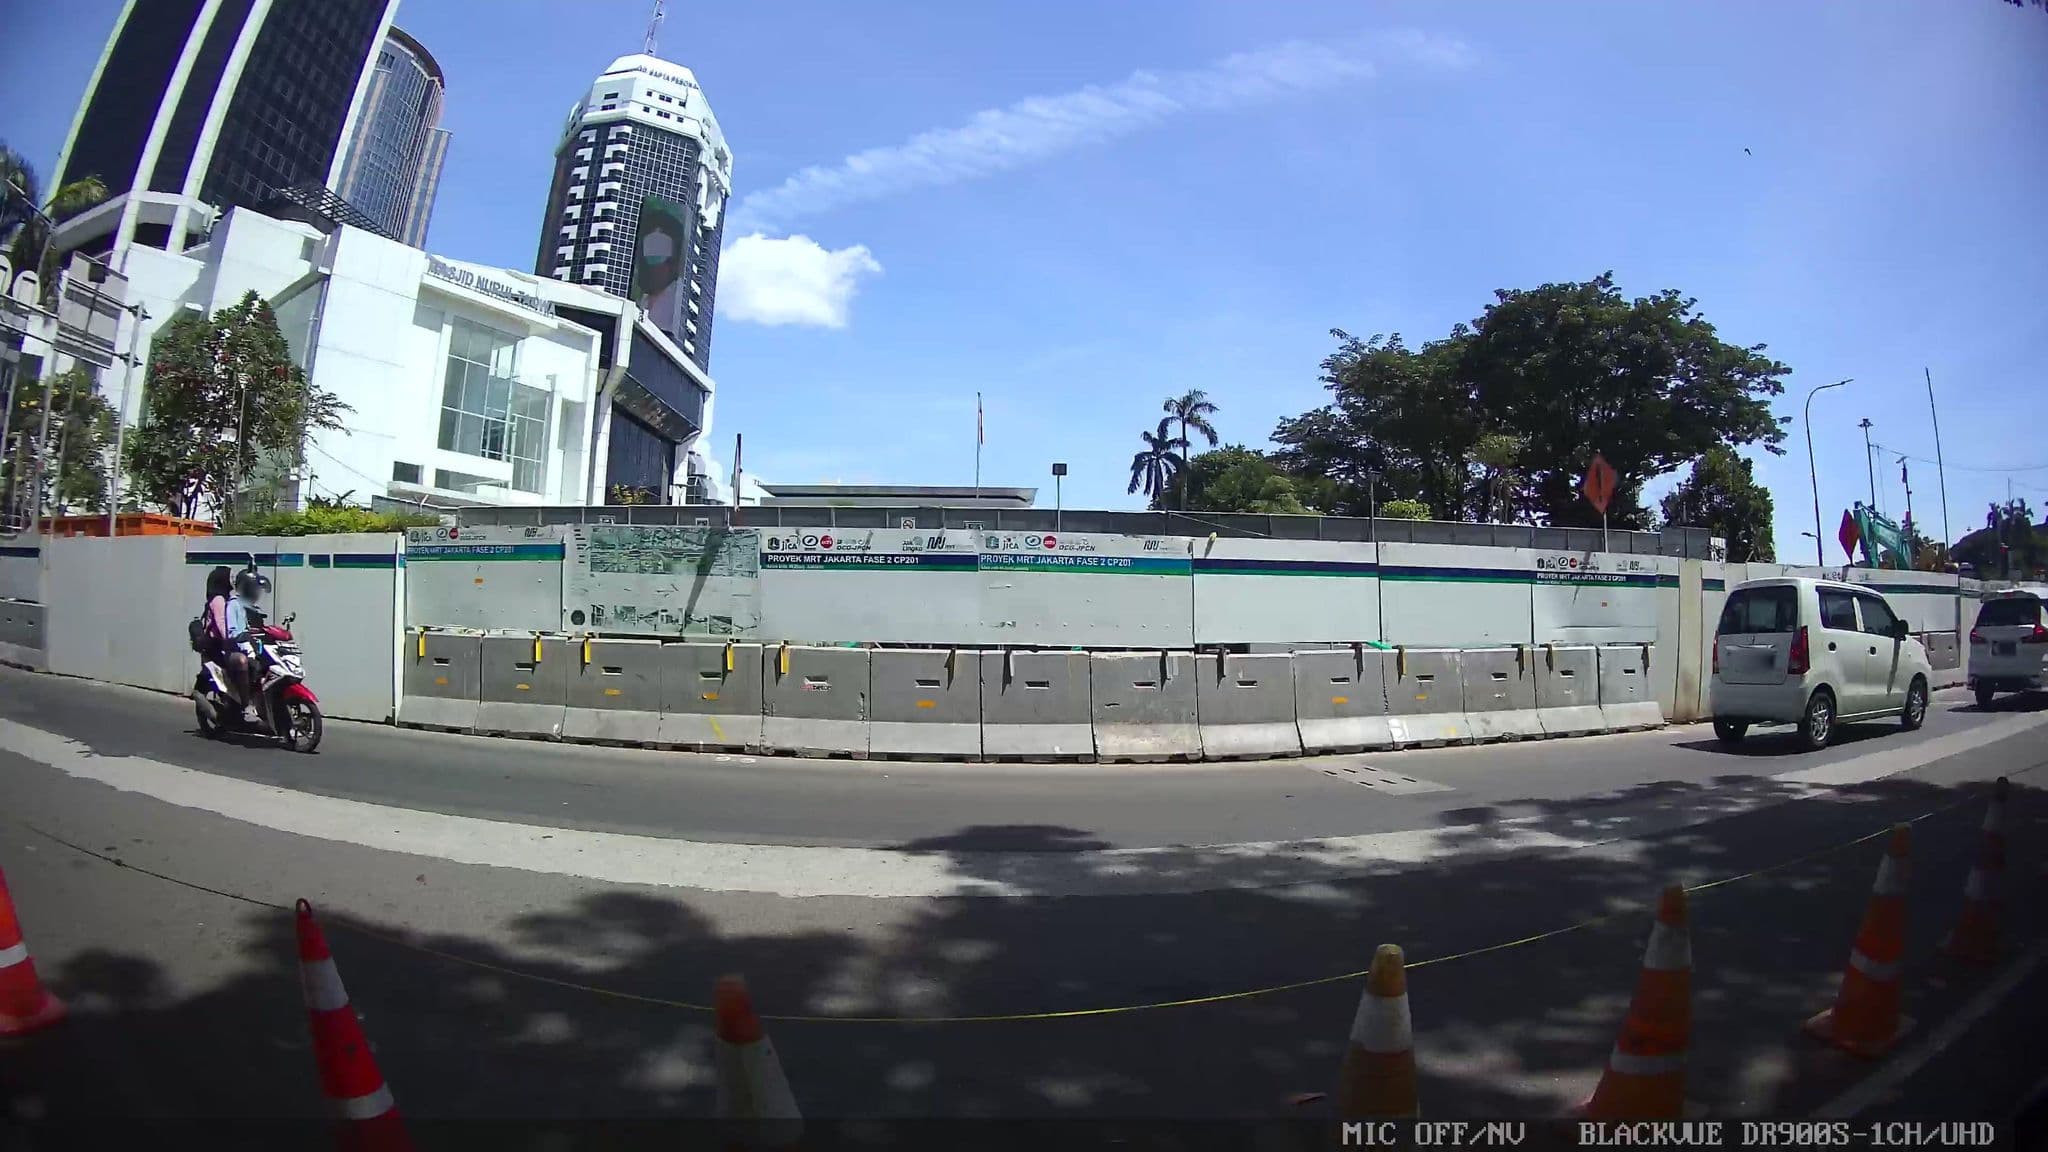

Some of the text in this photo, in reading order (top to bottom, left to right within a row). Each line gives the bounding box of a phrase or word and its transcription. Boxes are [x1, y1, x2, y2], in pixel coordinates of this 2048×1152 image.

[427, 258, 475, 287] MASJID
[472, 546, 489, 554] FASE
[767, 554, 919, 565] PROYEK MRT JAKARTA FASE 2 CP201
[980, 554, 1131, 567] PROYEK MRT JAKARTA FASE 2 CP201
